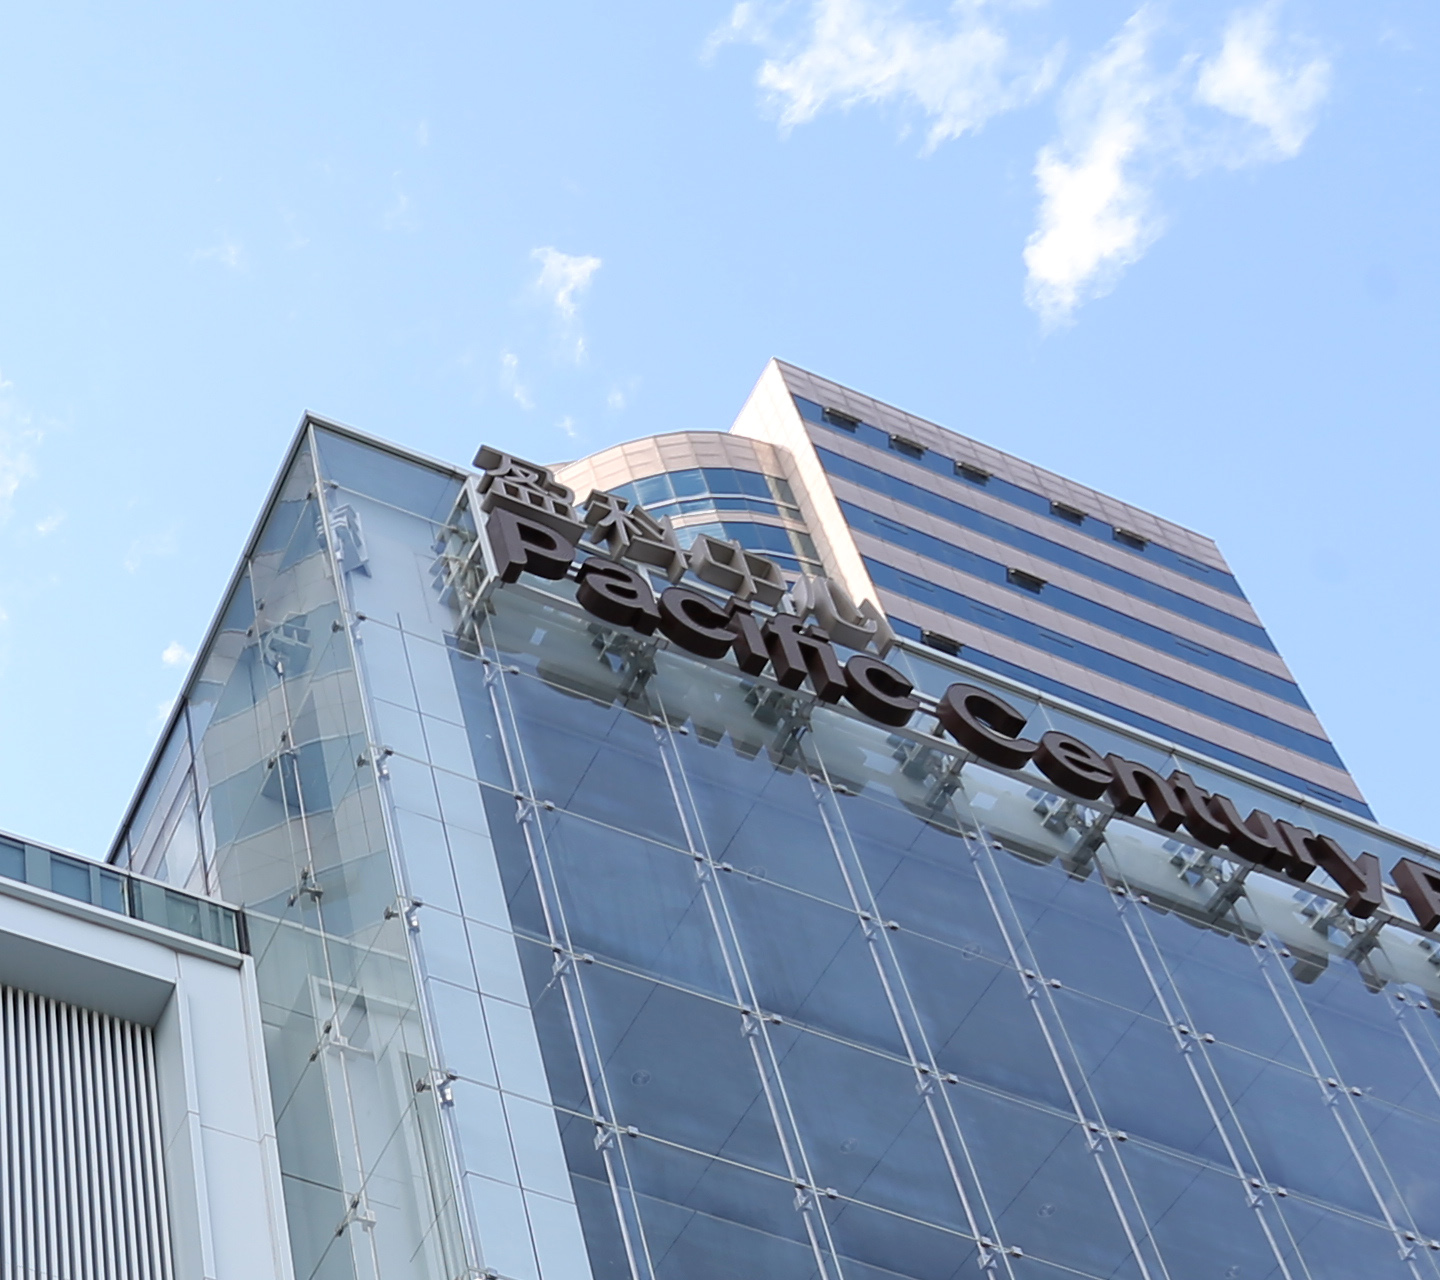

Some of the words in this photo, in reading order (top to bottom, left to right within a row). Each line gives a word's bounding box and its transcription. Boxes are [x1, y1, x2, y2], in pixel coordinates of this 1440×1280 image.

[472, 444, 898, 660] 盈科中心
[486, 506, 919, 728] Pacific
[935, 682, 1383, 919] Century
